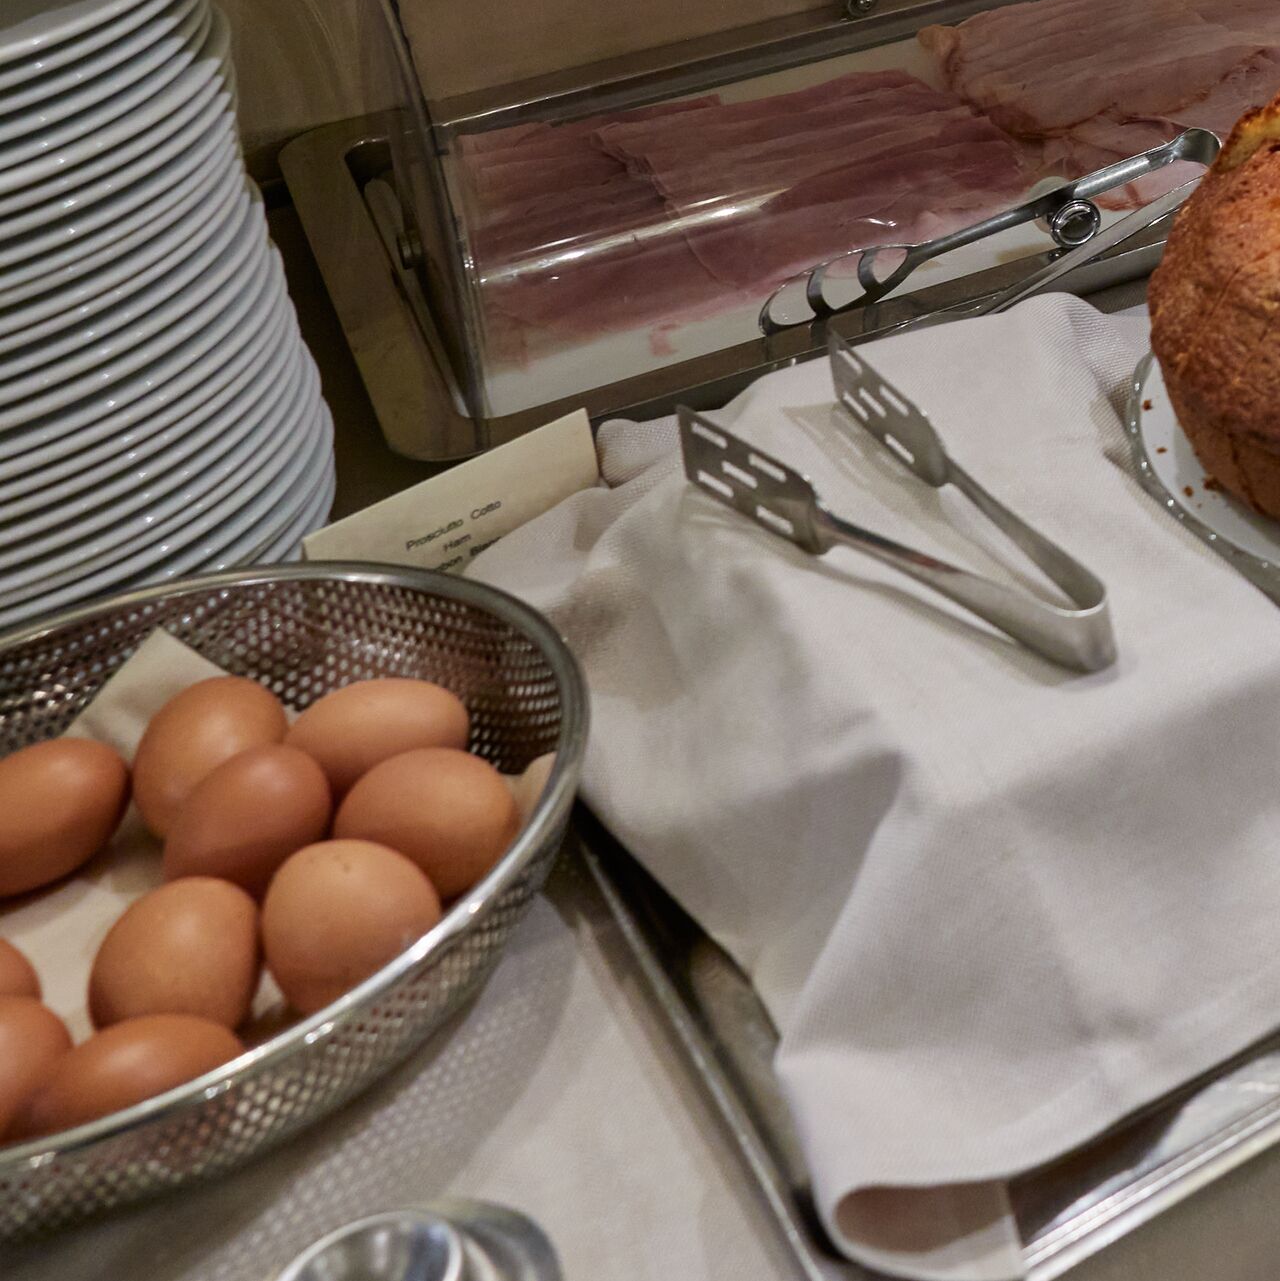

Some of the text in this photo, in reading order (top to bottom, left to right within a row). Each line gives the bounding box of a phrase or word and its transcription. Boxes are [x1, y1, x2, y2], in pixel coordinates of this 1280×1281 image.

[406, 501, 501, 551] Prosciutto Cotto
[443, 534, 472, 552] Ham
